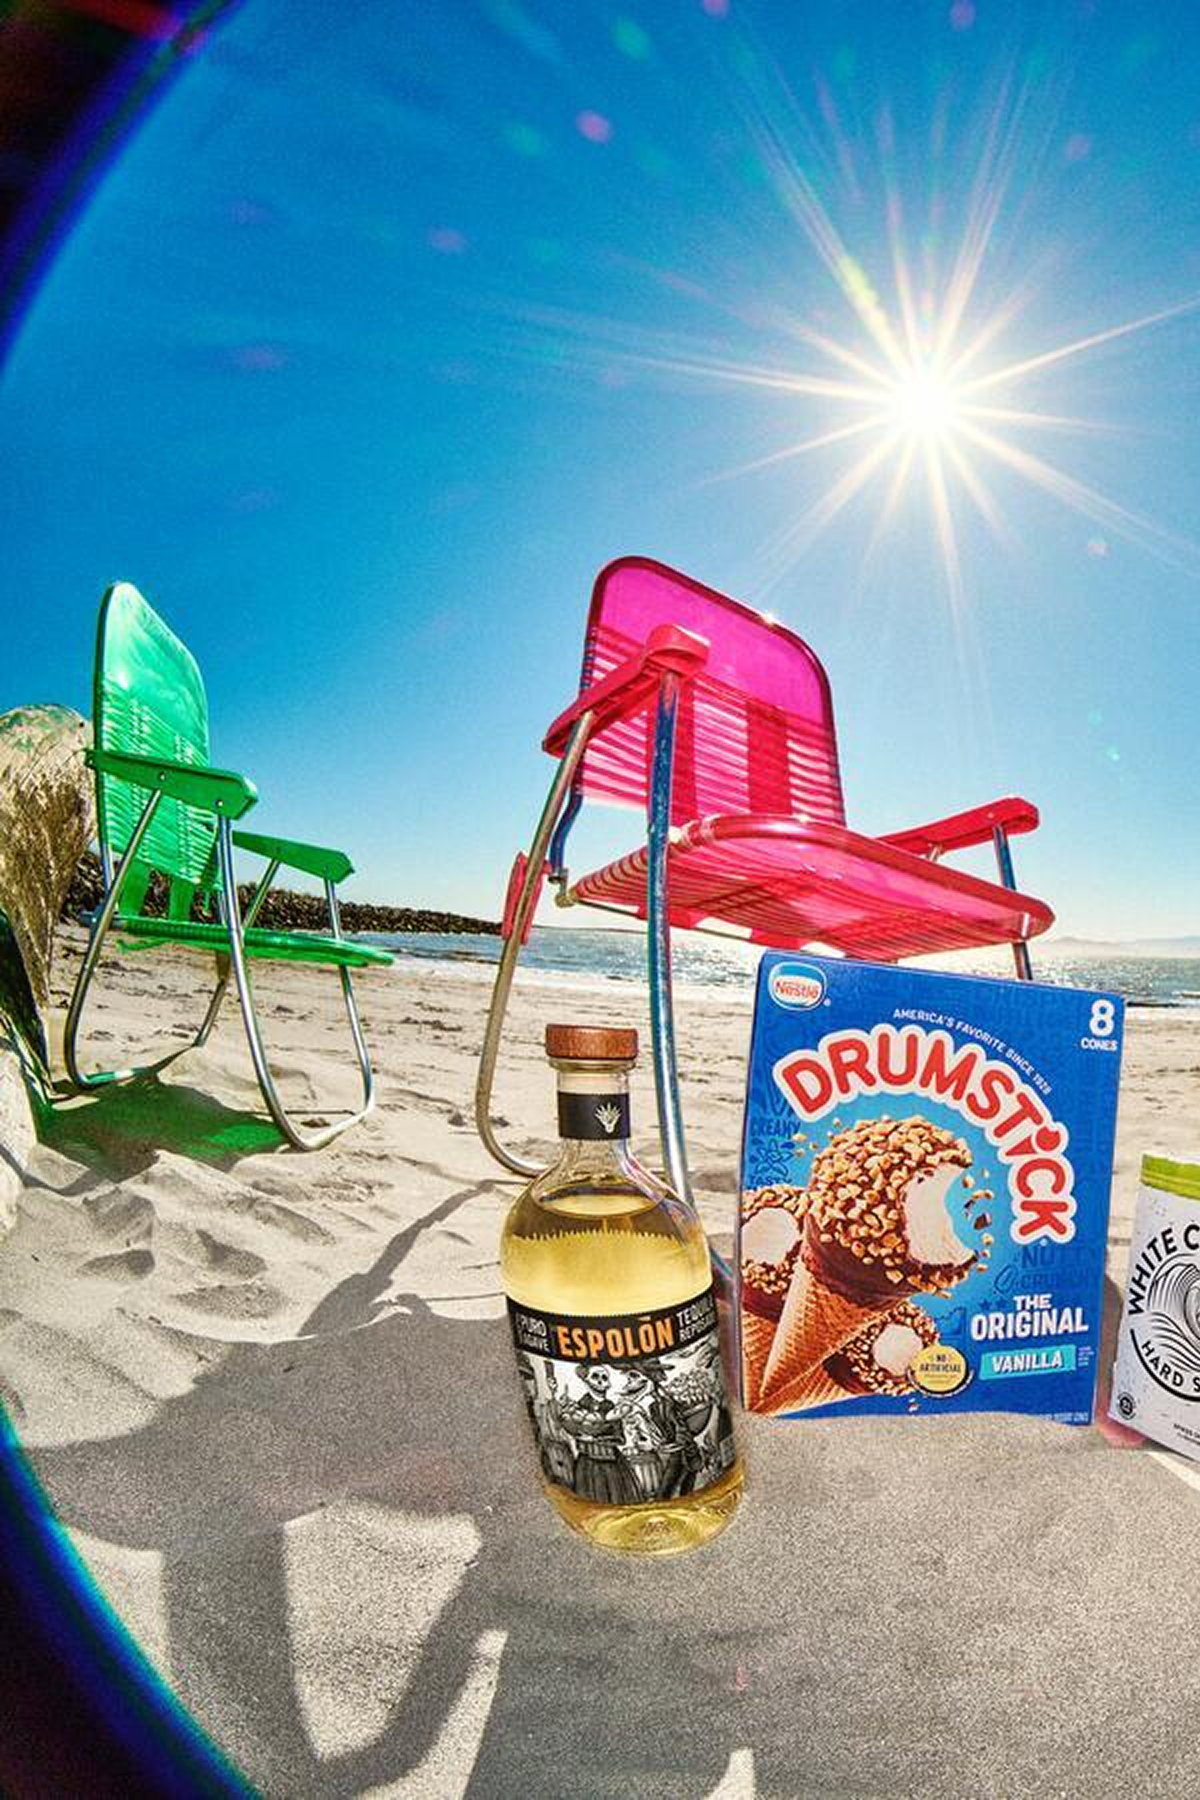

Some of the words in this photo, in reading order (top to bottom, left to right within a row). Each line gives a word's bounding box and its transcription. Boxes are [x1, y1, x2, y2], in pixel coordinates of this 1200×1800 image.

[1089, 999, 1115, 1037] 8
[893, 1008, 954, 1029] AMERICA'S
[955, 1022, 1004, 1052] FAVORITE
[1005, 1049, 1033, 1075] SINCE
[1080, 1036, 1118, 1051] CONES
[781, 1031, 1069, 1237] DRUMSTICK
[1128, 1228, 1177, 1316] WHITE
[1013, 1293, 1052, 1311] THE
[971, 1306, 1089, 1341] ORIGINAL
[991, 1349, 1064, 1374] VANILLA
[1141, 1341, 1185, 1388] HARD
